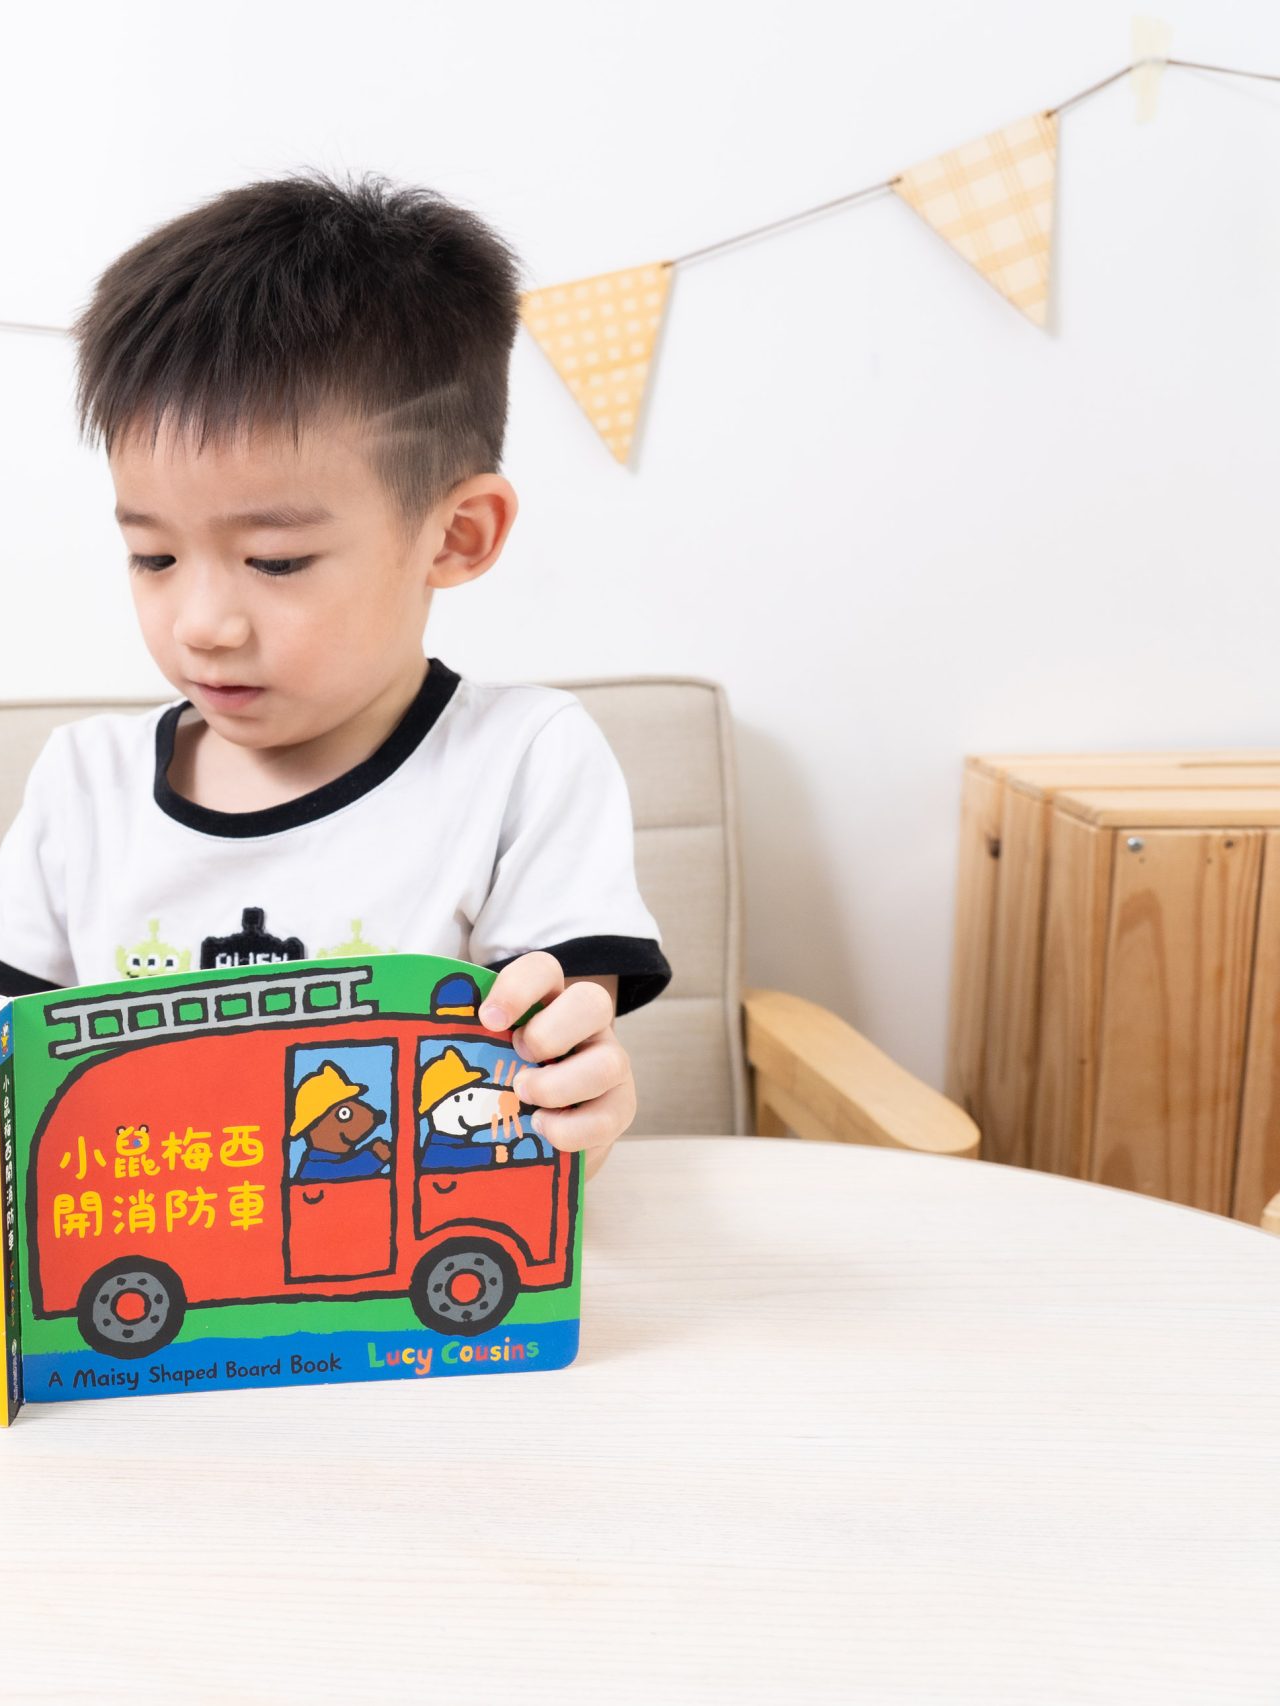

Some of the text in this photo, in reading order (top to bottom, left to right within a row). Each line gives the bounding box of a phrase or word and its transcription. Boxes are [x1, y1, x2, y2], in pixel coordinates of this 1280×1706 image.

[60, 1124, 265, 1179] 小鼠梅西
[53, 1180, 266, 1239] 開消防車
[48, 1371, 63, 1387] A
[148, 1362, 217, 1387] Shaped
[225, 1358, 281, 1378] Board
[290, 1352, 342, 1374] Book
[368, 1338, 540, 1375] Lucy Cousins
